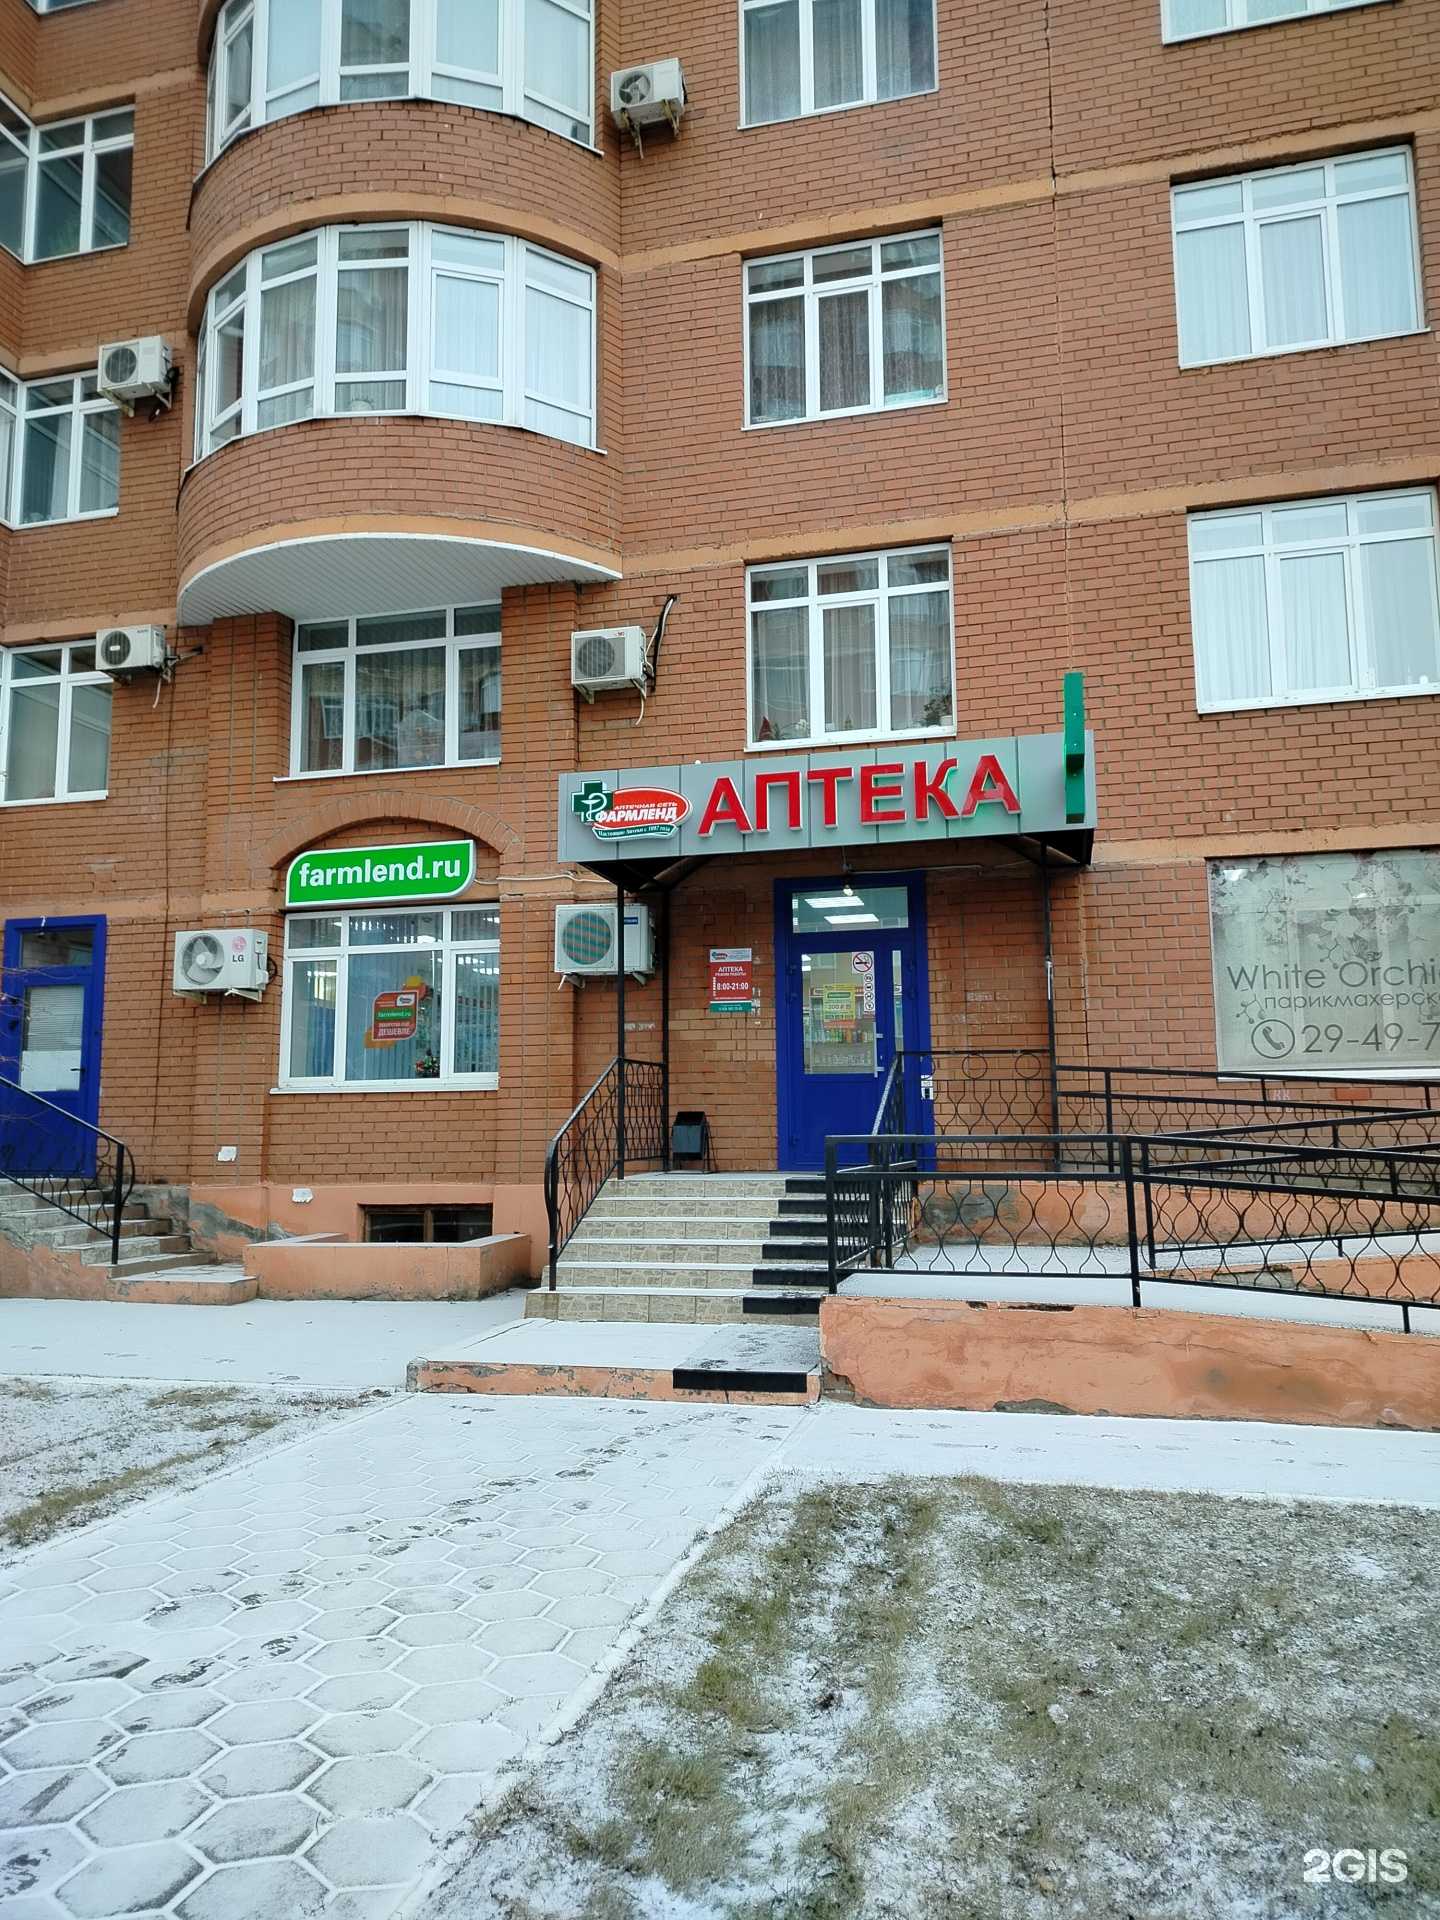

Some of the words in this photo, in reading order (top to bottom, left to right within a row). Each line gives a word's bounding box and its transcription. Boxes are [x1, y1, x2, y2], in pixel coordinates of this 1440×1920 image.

[697, 753, 1021, 838] АПТЕКА
[595, 806, 677, 823] ФАРМЛЕНД
[299, 855, 461, 888] farmlend.ru
[232, 954, 244, 963] LG
[717, 982, 749, 991] 8:00-21:00
[1227, 963, 1326, 990] White
[1339, 958, 1440, 987] Orchi
[1265, 991, 1440, 1012] парикмахерск
[1302, 1022, 1440, 1053] 29-49-7
